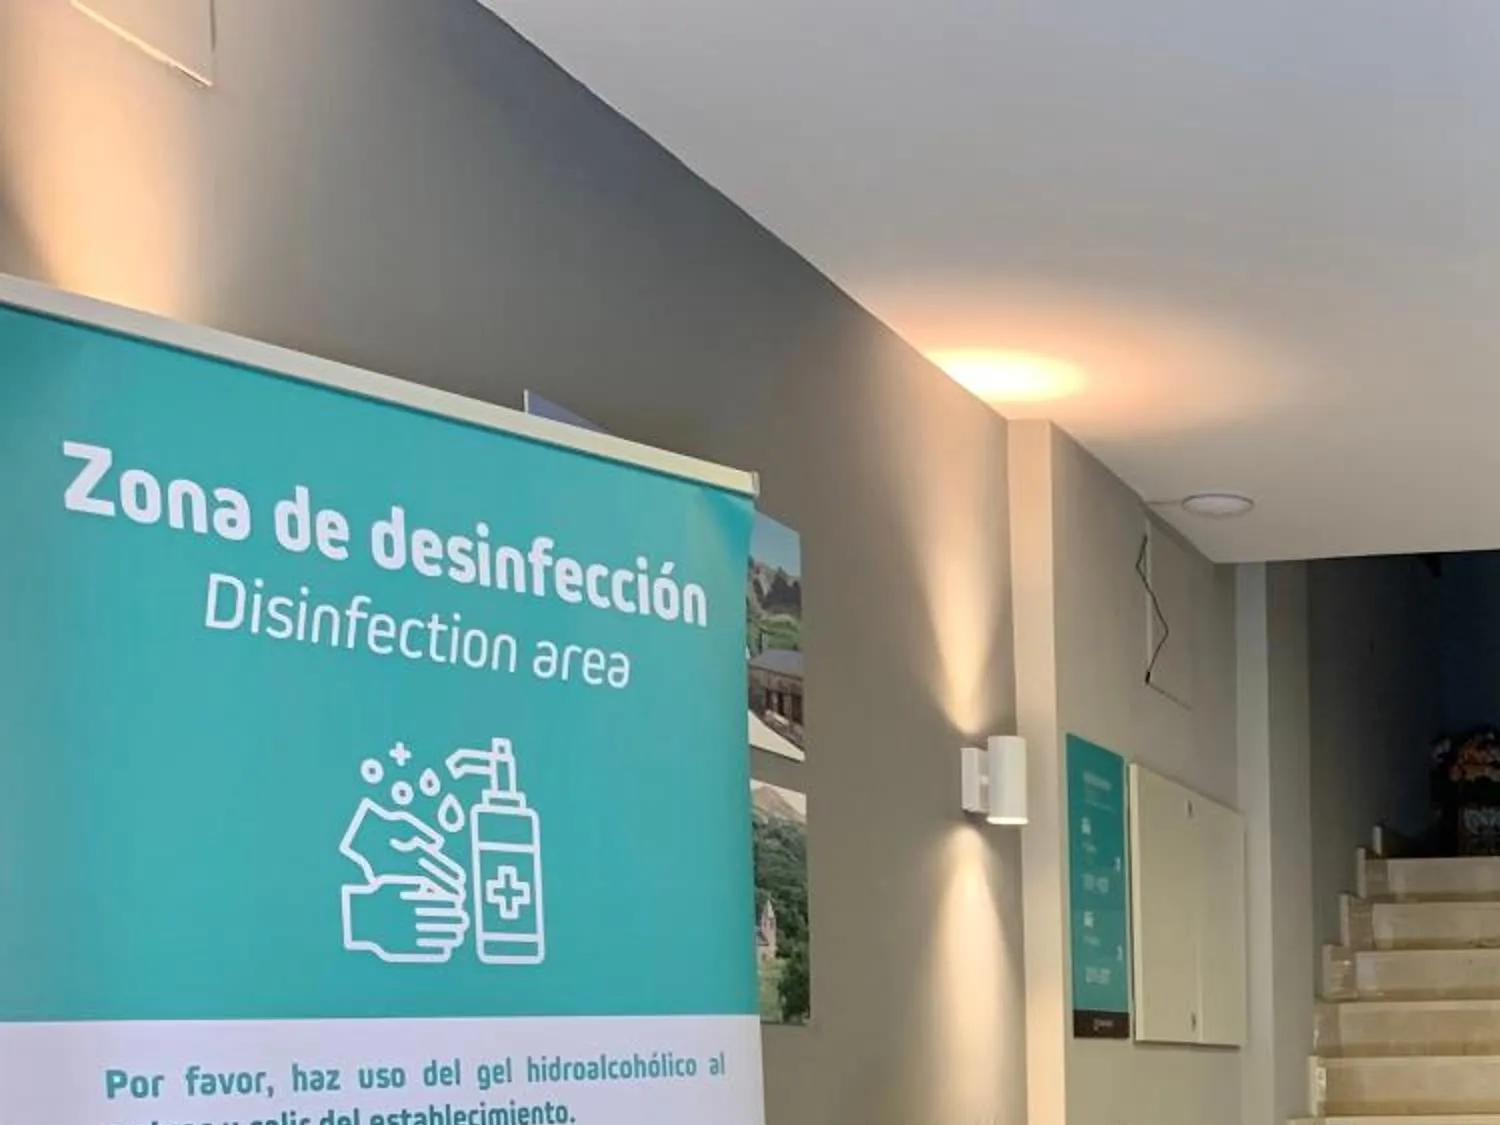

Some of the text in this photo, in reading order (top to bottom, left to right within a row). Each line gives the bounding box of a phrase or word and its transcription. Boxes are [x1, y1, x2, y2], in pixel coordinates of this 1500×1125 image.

[63, 440, 707, 627] Zona de desinfección
[205, 573, 630, 688] Disinfection area
[105, 1052, 724, 1099] Por favor, haz uso del gel hidroalcohólico al
